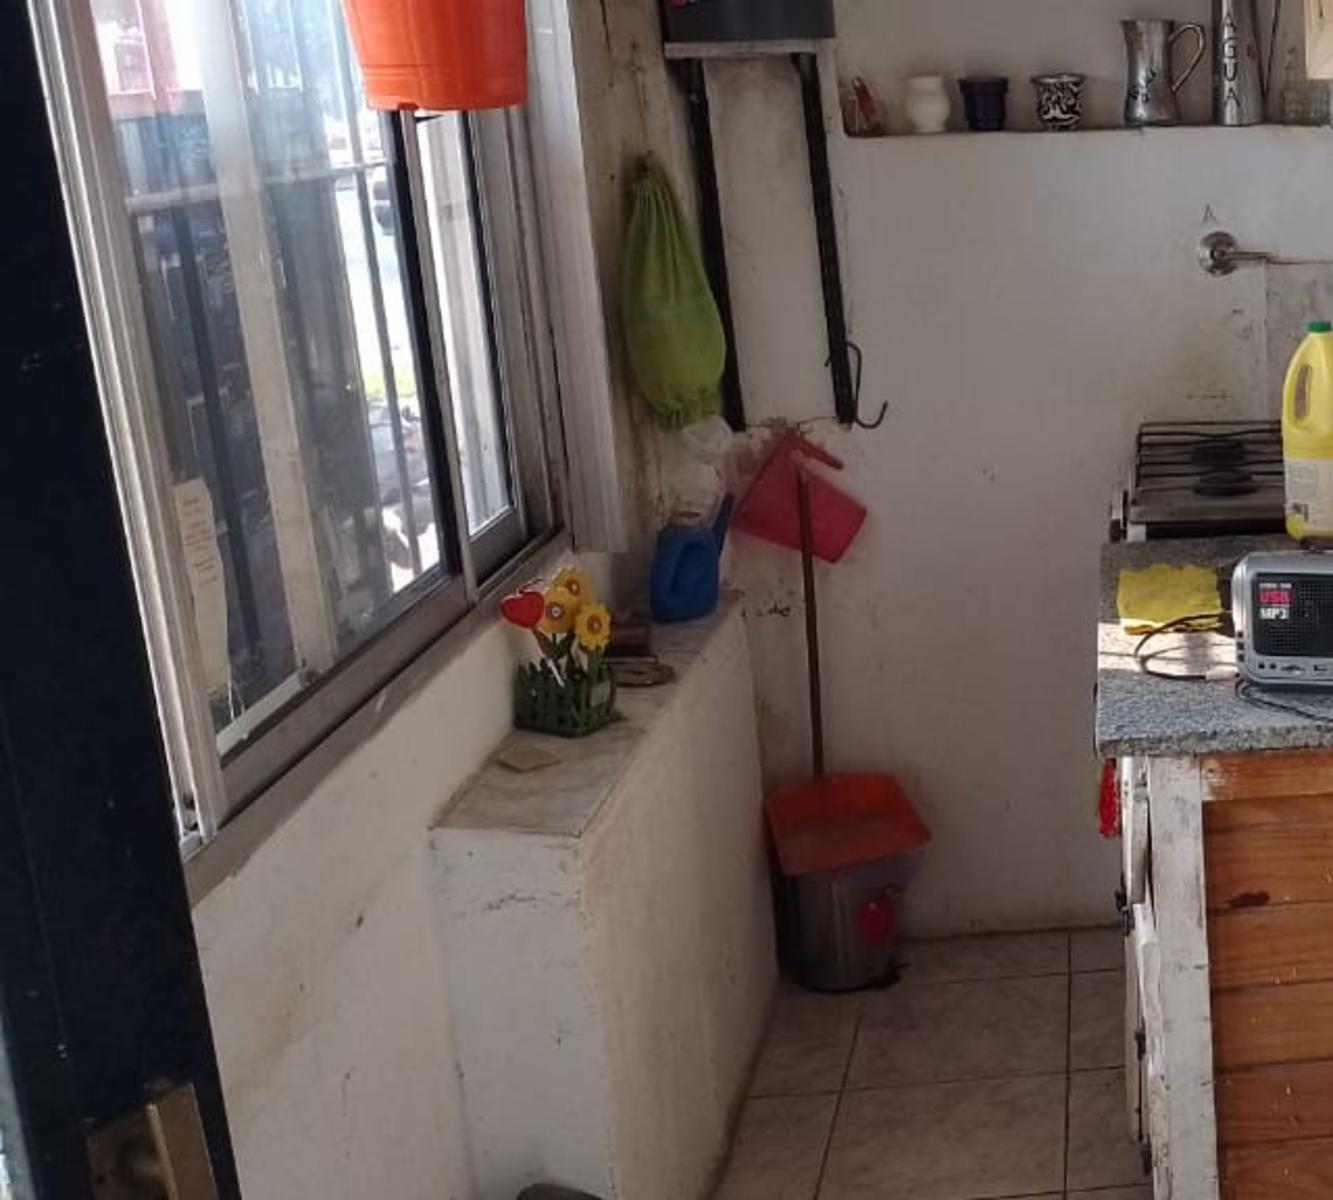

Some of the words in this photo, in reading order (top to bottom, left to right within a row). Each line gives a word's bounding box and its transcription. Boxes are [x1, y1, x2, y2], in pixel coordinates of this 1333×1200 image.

[1223, 13, 1240, 107] AGUA
[1259, 590, 1290, 604] USB
[1260, 606, 1289, 620] MP3
